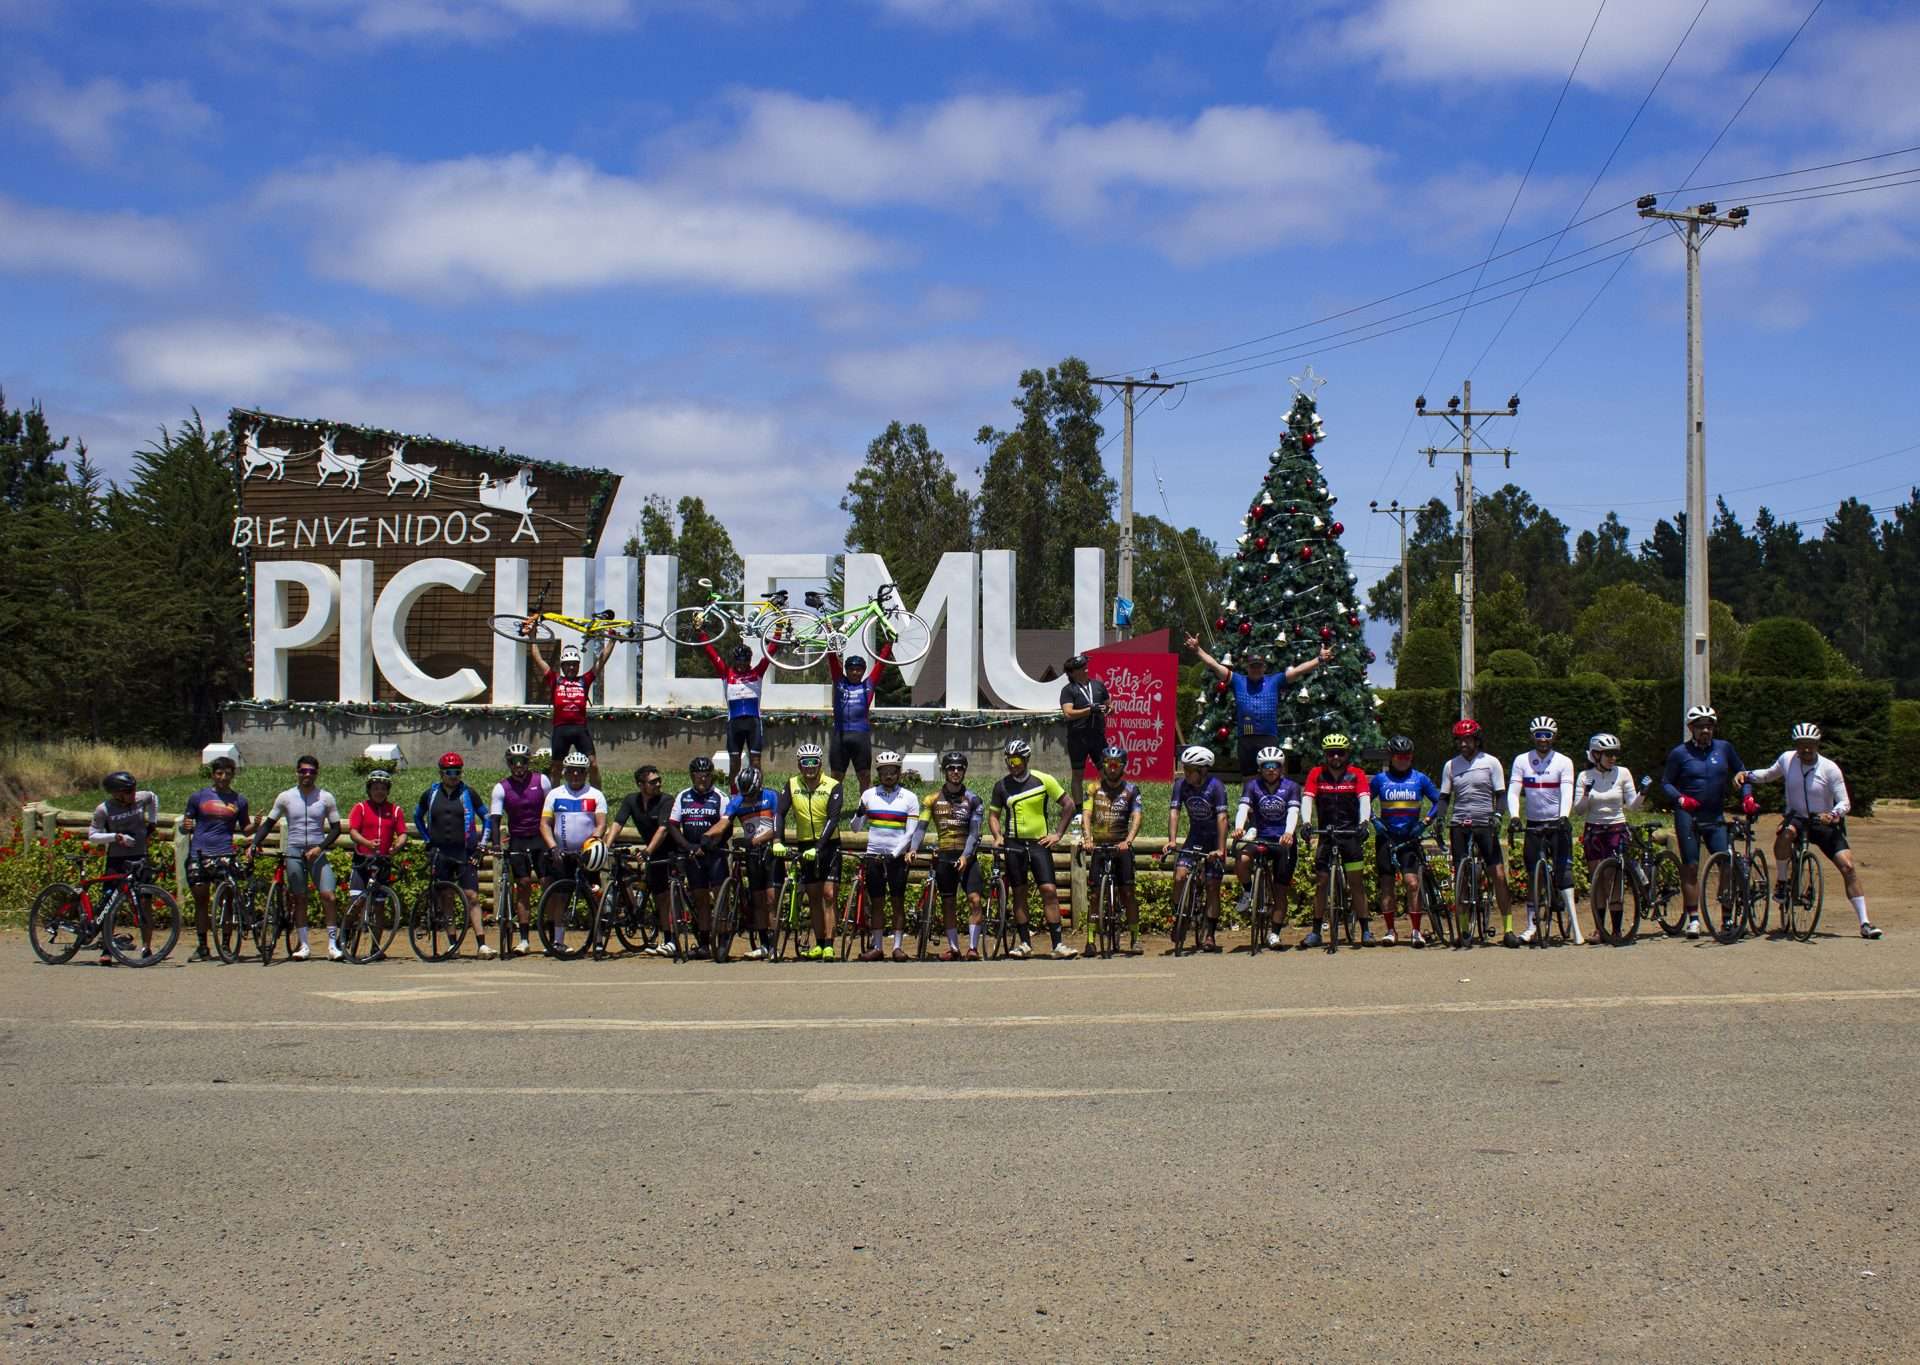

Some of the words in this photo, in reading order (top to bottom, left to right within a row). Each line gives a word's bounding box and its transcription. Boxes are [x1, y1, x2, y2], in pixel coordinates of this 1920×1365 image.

[231, 510, 494, 549] BIENVENIDOS
[510, 511, 541, 545] A
[252, 546, 1105, 712] PICHILEMU
[1104, 667, 1141, 692] Feliz
[1117, 731, 1163, 753] Nuevo
[1385, 788, 1416, 801] Colombia
